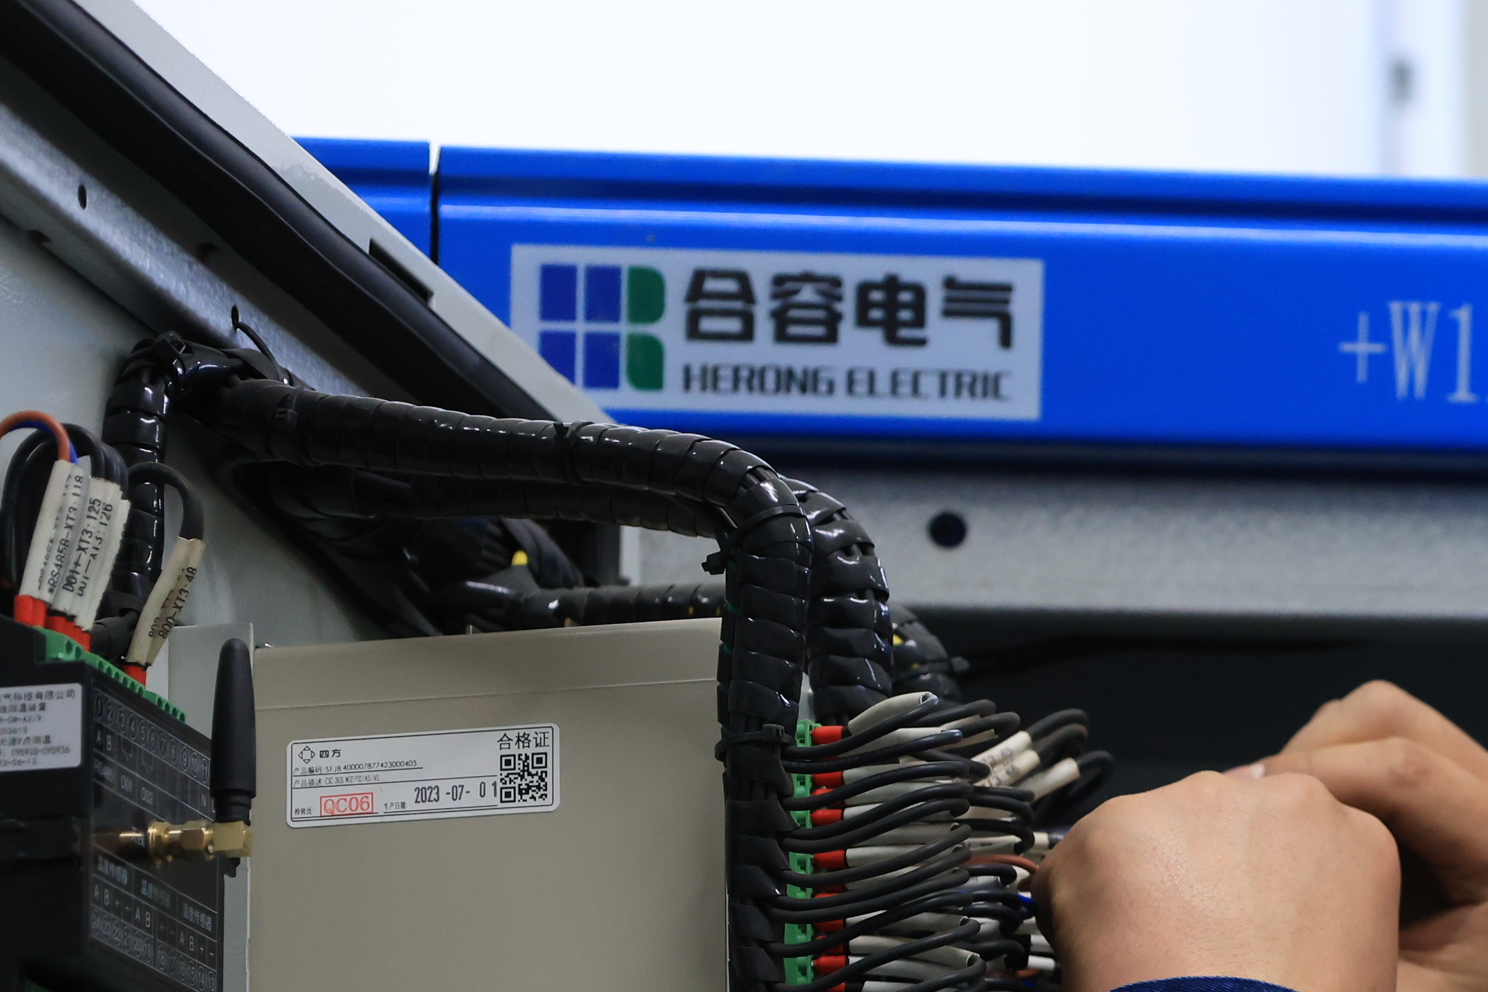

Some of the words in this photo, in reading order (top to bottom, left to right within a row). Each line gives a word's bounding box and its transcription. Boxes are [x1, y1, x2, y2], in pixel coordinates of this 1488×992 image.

[684, 267, 1015, 349] 合容电气
[683, 362, 835, 397] HERONG
[846, 367, 1012, 402] ELECTRIC
[319, 749, 341, 758] 四方
[497, 731, 550, 750] 合格证
[323, 796, 371, 815] QC06
[414, 785, 440, 804] 2023
